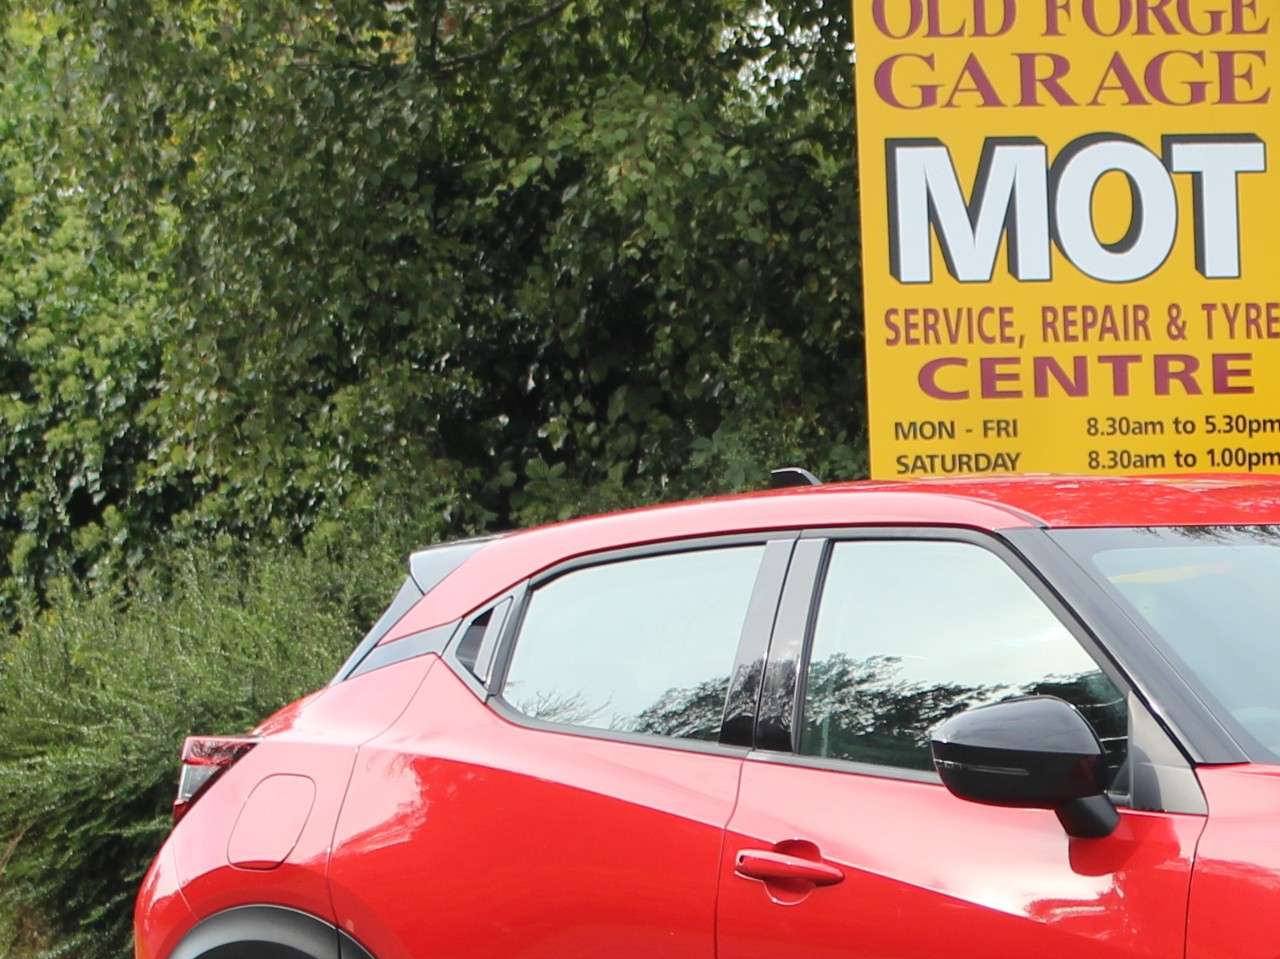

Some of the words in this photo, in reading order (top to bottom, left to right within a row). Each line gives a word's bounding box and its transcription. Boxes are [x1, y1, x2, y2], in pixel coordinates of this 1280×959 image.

[872, 0, 1016, 39] OLD
[1040, 0, 1270, 38] FORGE
[873, 49, 1272, 110] GARAGE
[885, 132, 1266, 284] MOT
[884, 305, 1026, 348] SERVICE,
[1041, 303, 1151, 342] REPAIR
[1166, 303, 1187, 340] &
[917, 353, 1255, 400] CENTRE
[895, 421, 955, 440] MON
[982, 419, 1018, 438] FRI
[1087, 417, 1165, 436] 8.30am
[1173, 417, 1196, 435] to
[896, 452, 1021, 473] SATURDAY
[1088, 450, 1165, 469] 8.30am
[1173, 450, 1196, 468] to
